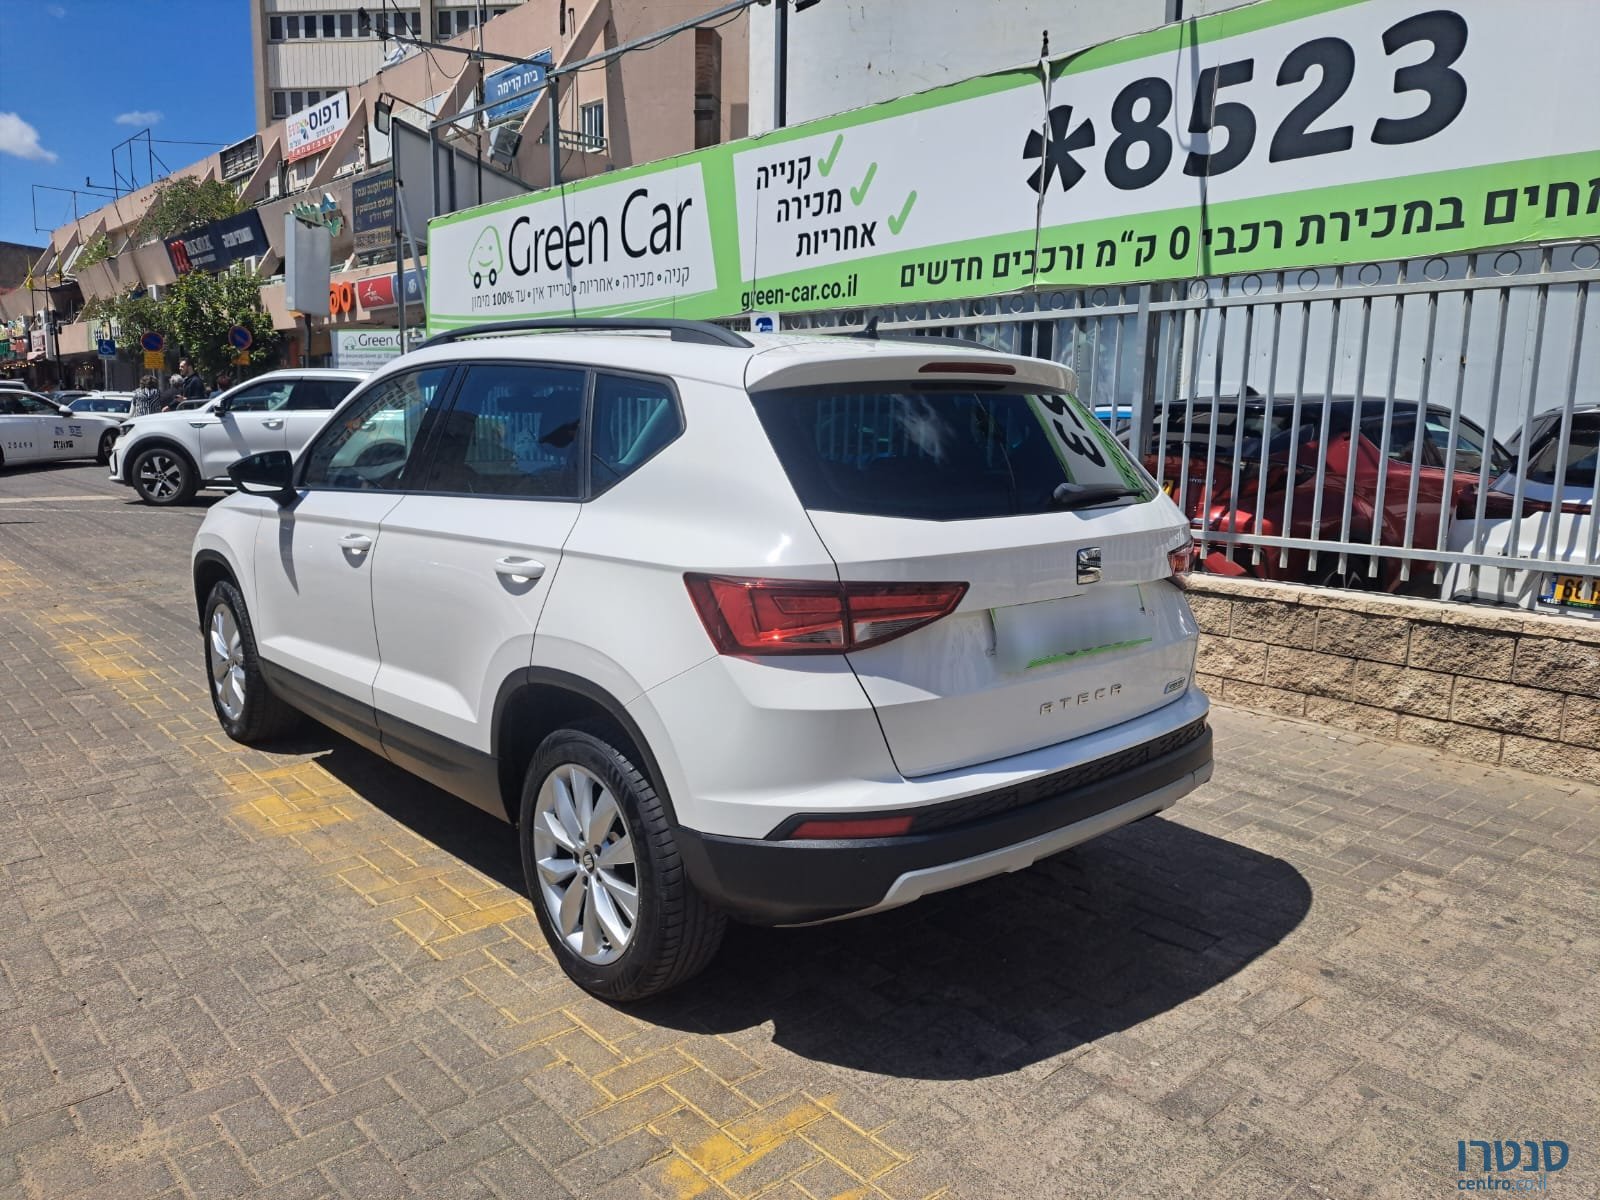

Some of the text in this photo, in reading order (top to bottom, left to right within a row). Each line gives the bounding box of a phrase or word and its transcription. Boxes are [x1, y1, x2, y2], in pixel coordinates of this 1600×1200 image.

[523, 69, 539, 86] בית
[308, 100, 340, 131] דפוס
[756, 155, 812, 191] קנייה
[776, 188, 842, 223] מכירה
[1295, 196, 1465, 248] במכירת
[508, 187, 693, 277] Green Car
[795, 220, 877, 257] אחריות
[1168, 225, 1191, 262] 0
[1202, 219, 1283, 257] רכבי
[900, 256, 983, 288] חדשים
[992, 243, 1085, 279] ורכבים
[471, 266, 690, 312] קניה מכירה אחריות טרייד אין עד 100% מימון
[740, 273, 858, 312] green-car.co.il
[358, 333, 393, 347] Green
[1039, 683, 1122, 716] ATECA
